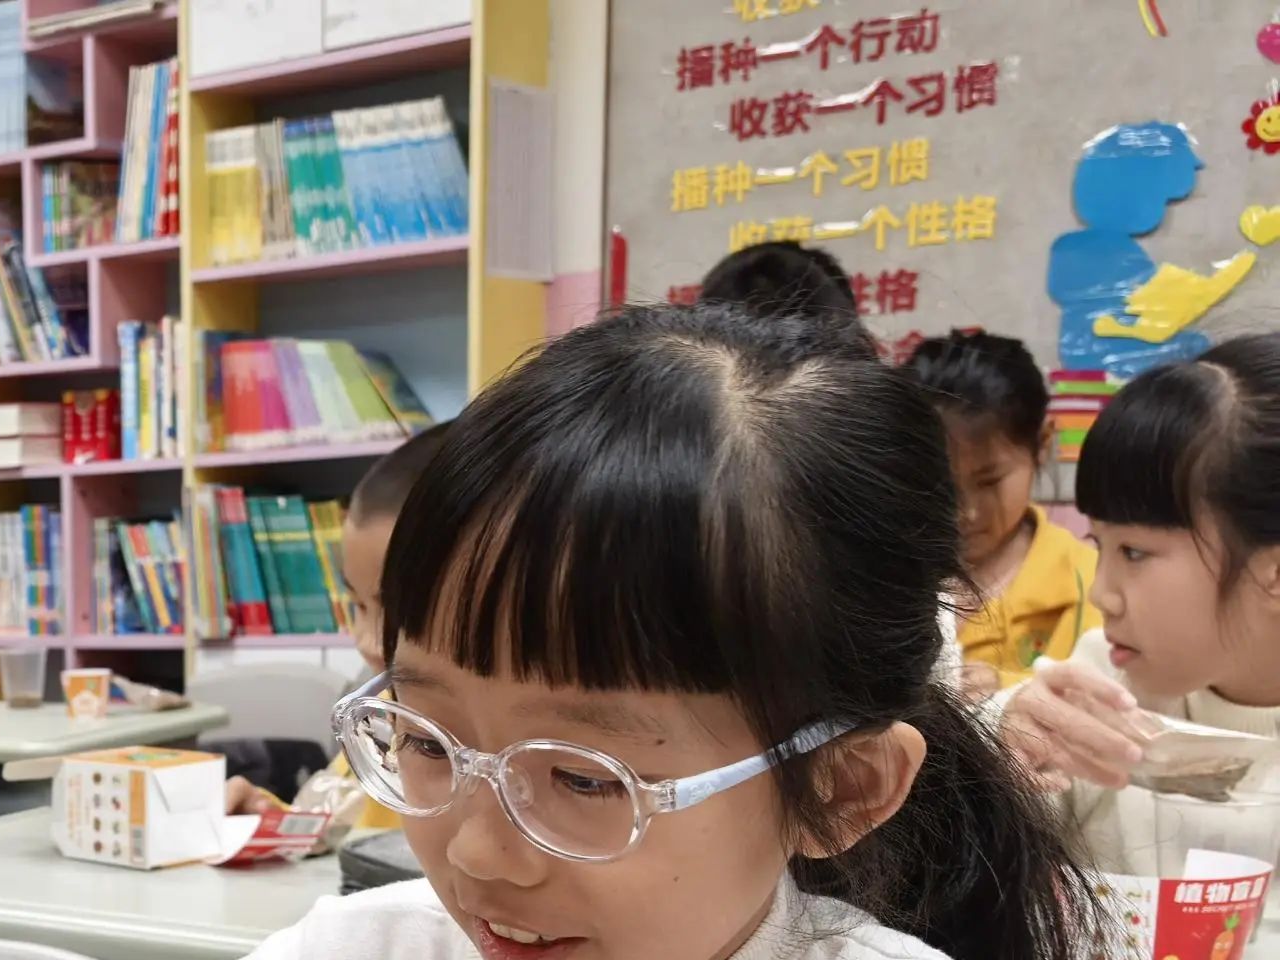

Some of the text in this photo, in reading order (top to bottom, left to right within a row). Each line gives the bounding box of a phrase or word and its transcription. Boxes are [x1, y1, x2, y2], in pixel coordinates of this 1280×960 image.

[676, 9, 940, 91] 播种一个行动
[729, 62, 999, 141] 收获一个习惯
[670, 138, 930, 212] 播种一个习惯
